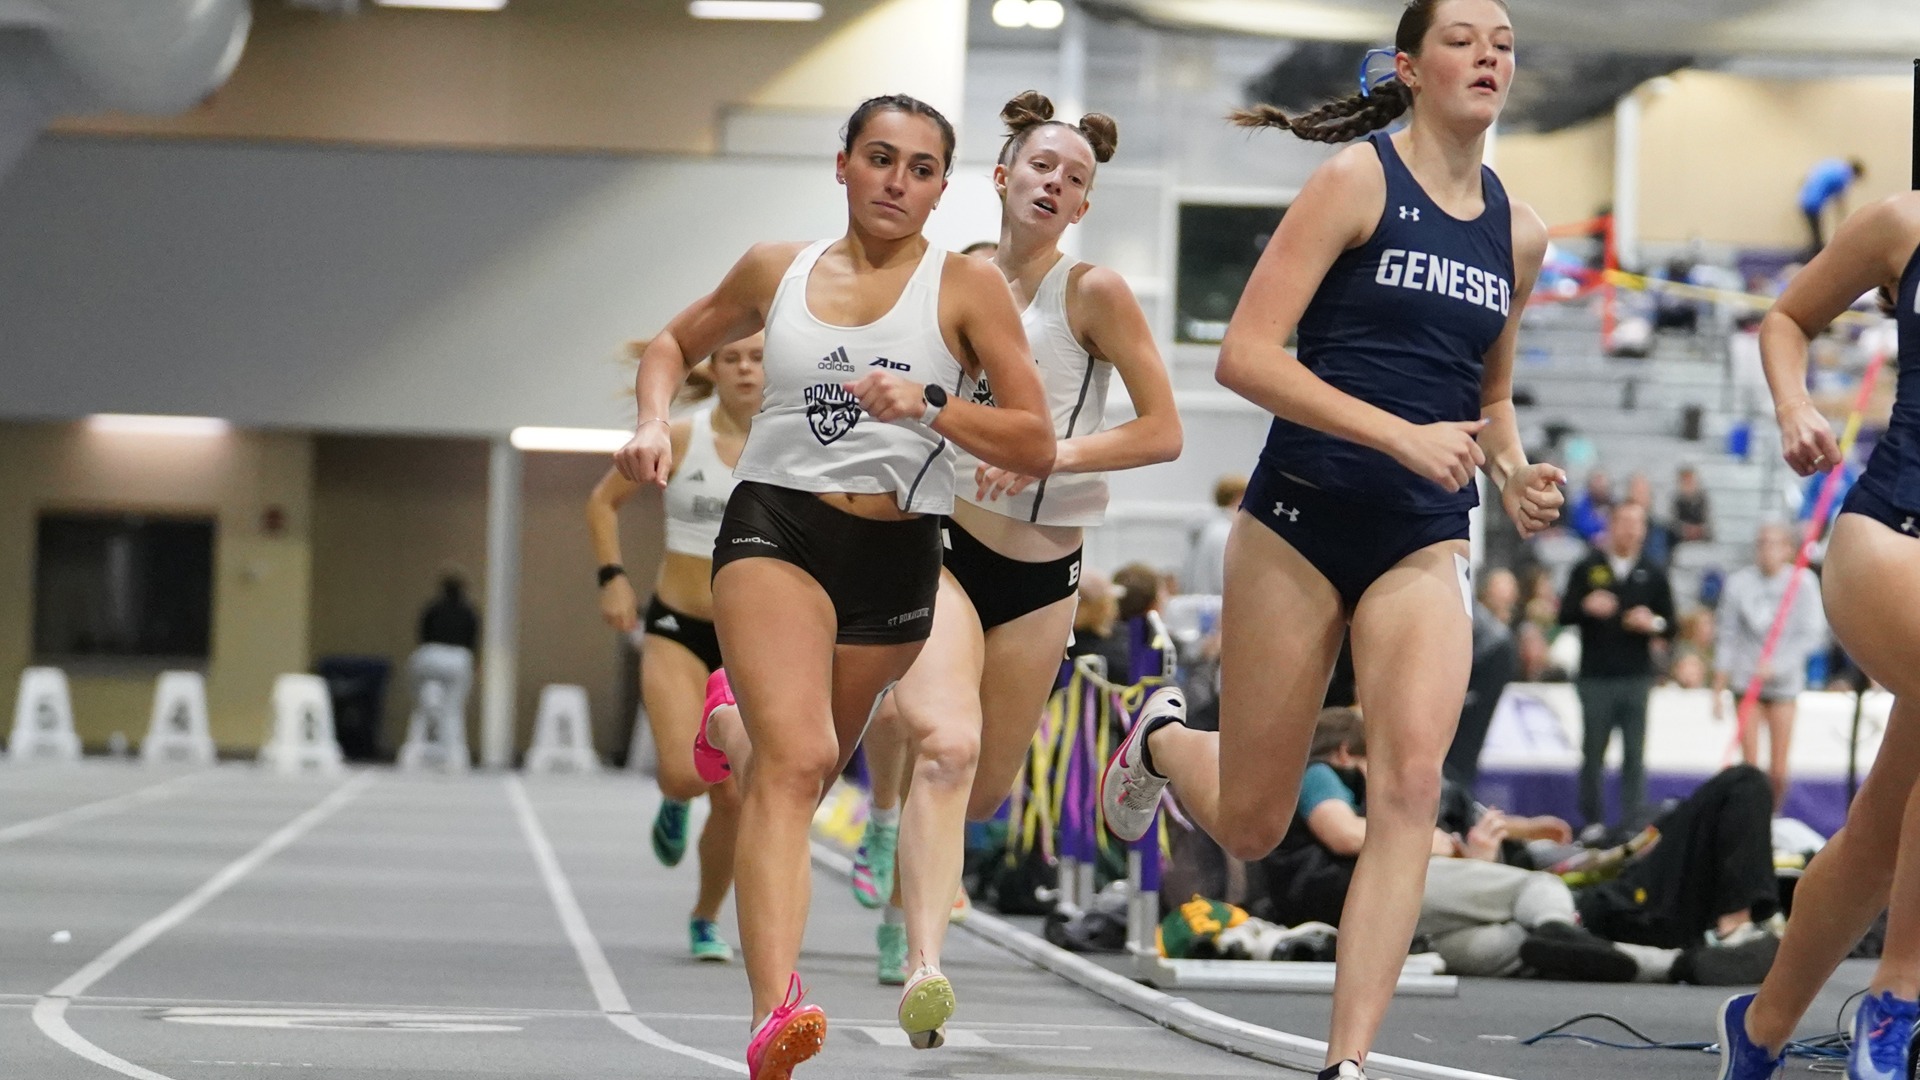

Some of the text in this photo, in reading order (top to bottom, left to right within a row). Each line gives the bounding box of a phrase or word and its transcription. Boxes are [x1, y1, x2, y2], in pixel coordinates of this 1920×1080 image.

[1375, 248, 1512, 318] GENESEO
[817, 361, 855, 373] adidas
[869, 356, 911, 372] A10
[1067, 560, 1081, 587] B
